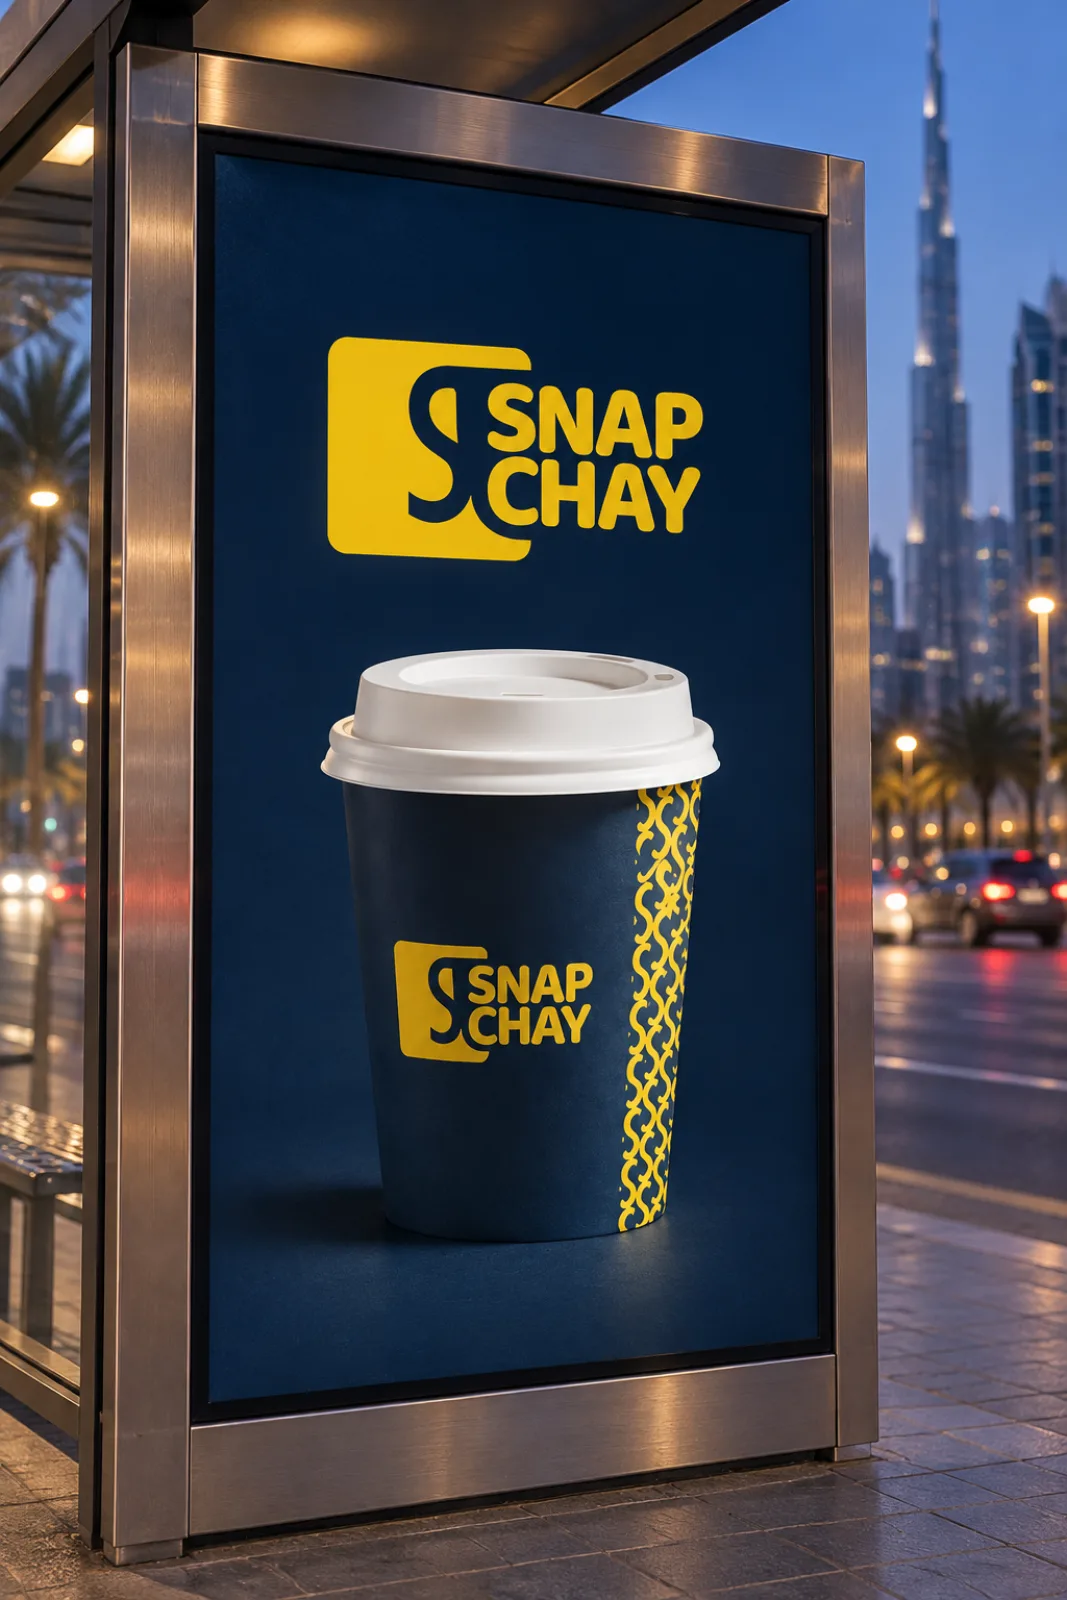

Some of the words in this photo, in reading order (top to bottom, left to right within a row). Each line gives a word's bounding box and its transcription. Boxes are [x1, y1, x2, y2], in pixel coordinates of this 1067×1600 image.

[488, 383, 703, 459] SNAP
[488, 456, 700, 533] CHAY
[468, 963, 593, 1004] SNAP
[469, 1004, 591, 1045] CHAY
